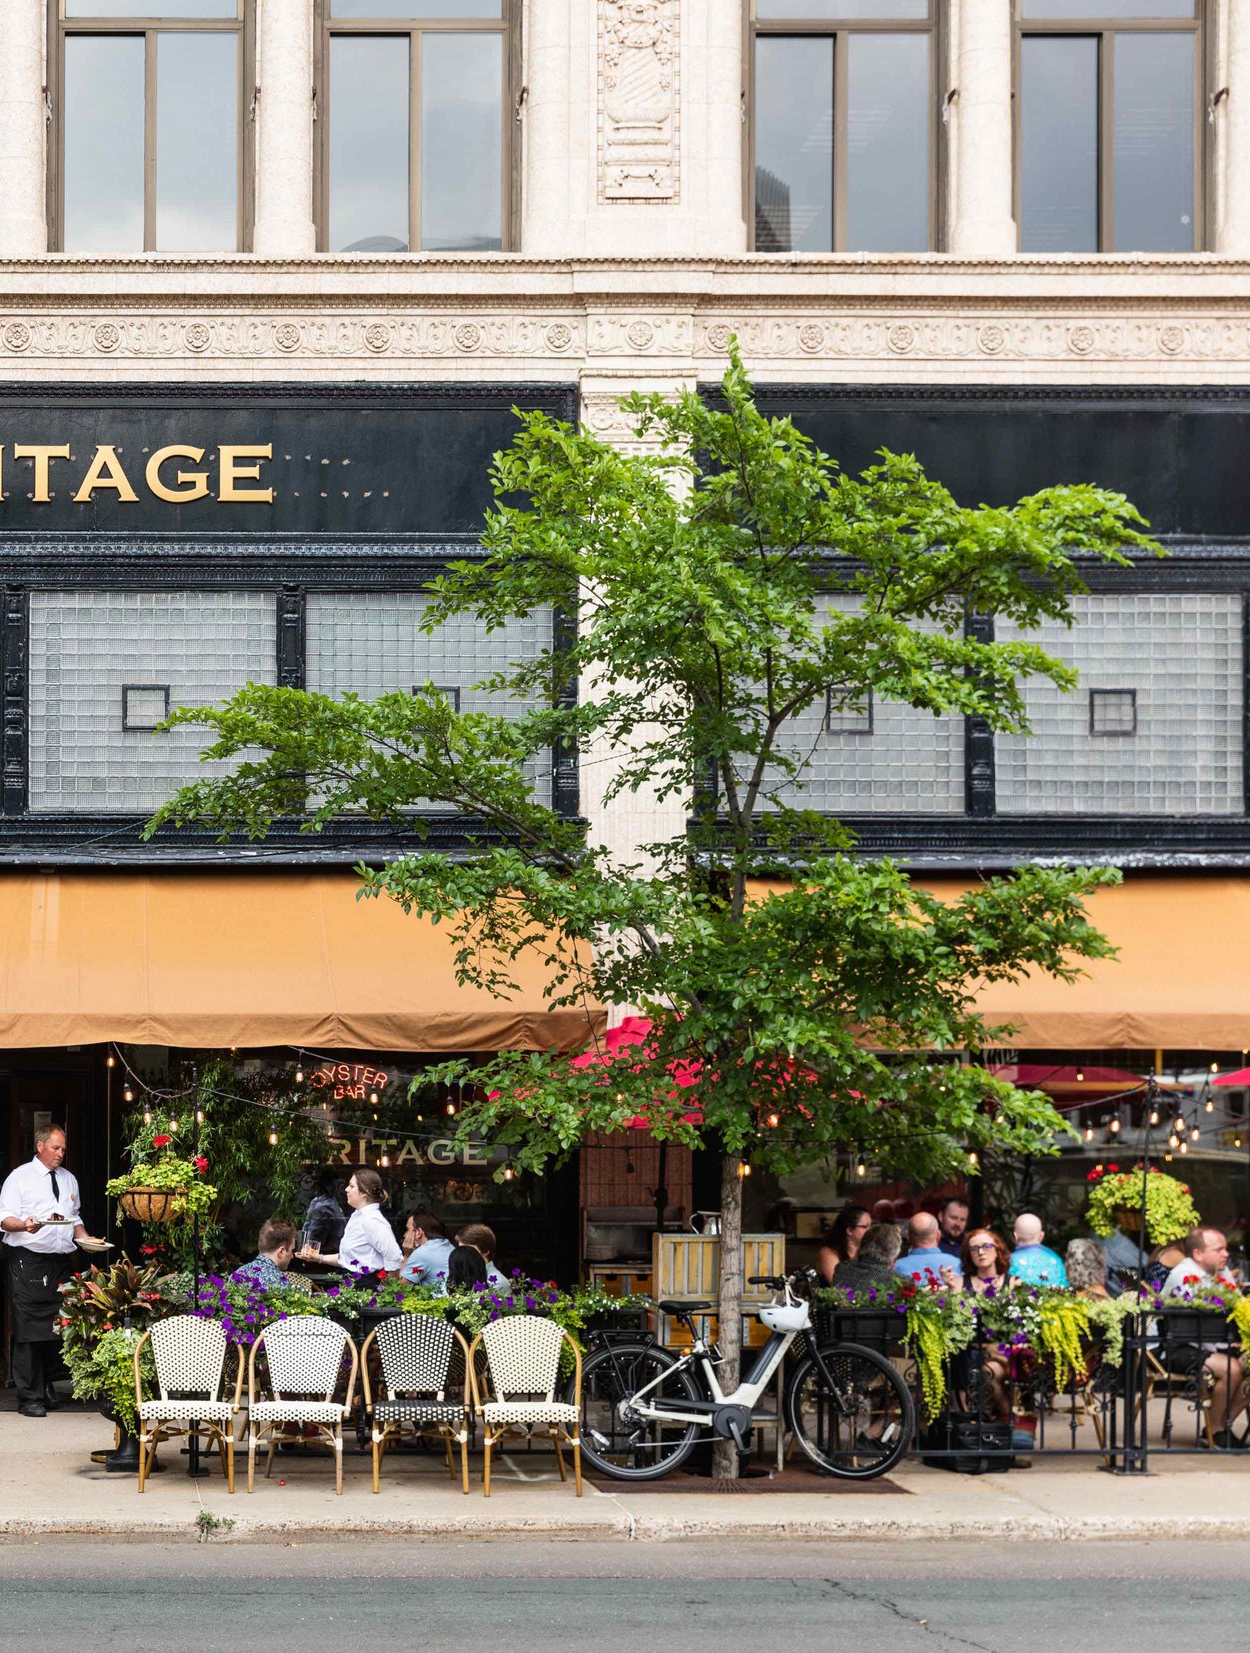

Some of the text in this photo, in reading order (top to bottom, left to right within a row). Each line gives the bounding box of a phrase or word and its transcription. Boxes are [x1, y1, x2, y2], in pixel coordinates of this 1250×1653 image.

[311, 1064, 389, 1089] OYSTER
[333, 1084, 366, 1100] BAR
[302, 1139, 488, 1166] RITAGE
